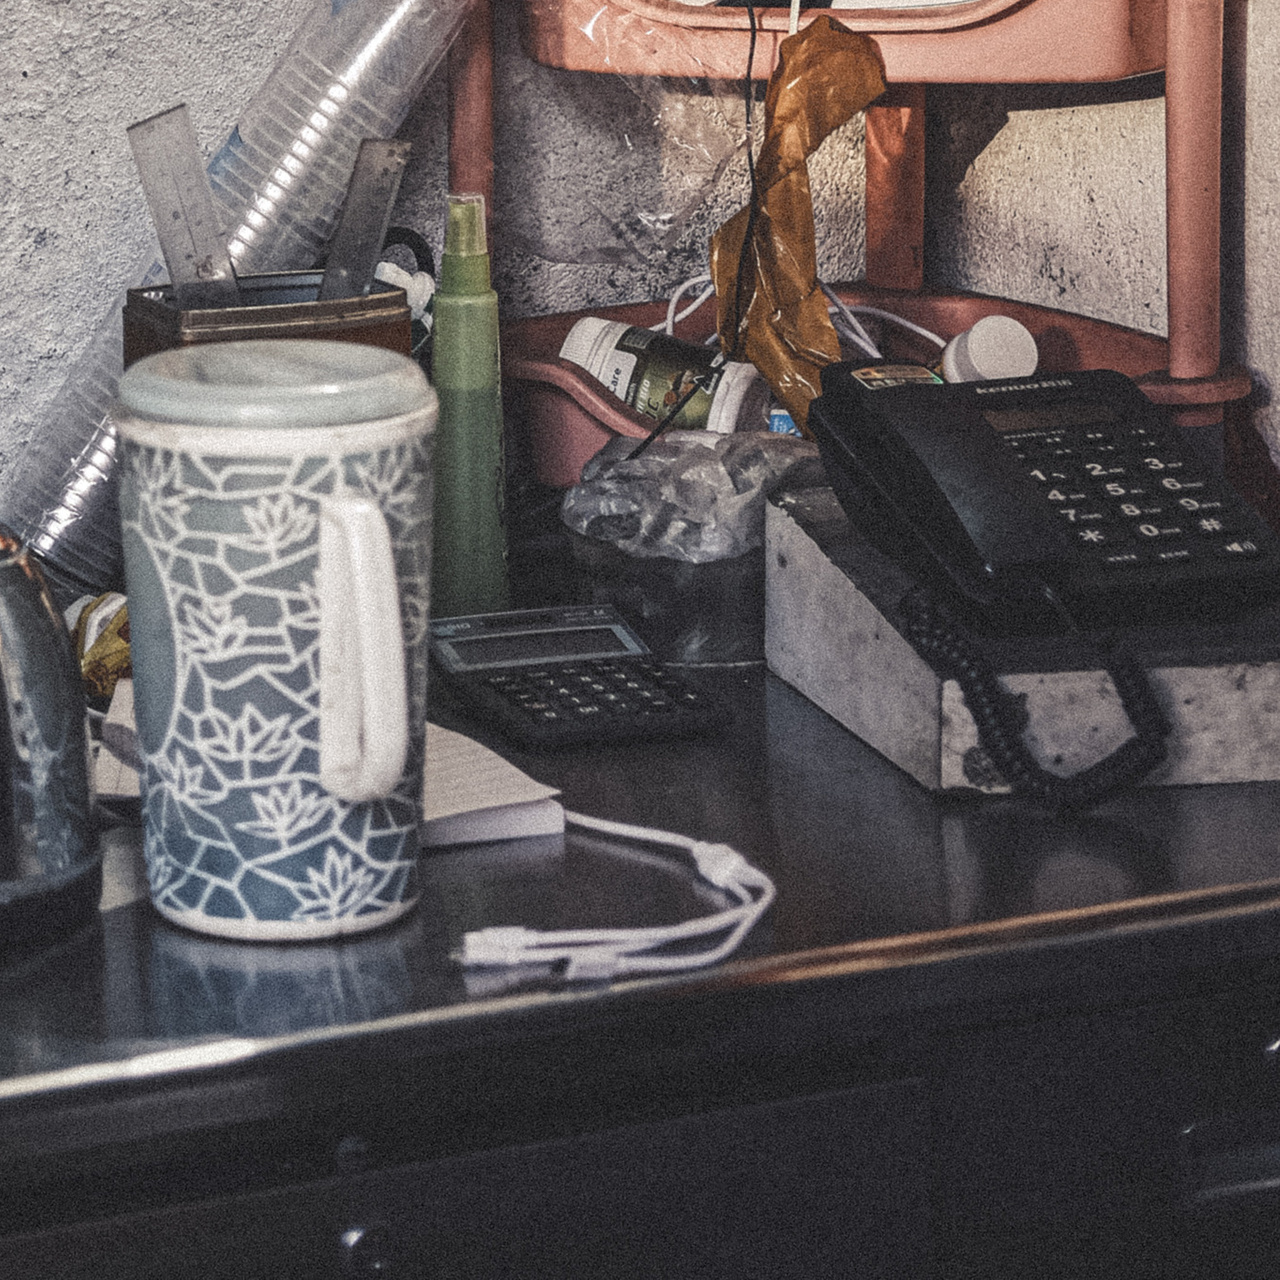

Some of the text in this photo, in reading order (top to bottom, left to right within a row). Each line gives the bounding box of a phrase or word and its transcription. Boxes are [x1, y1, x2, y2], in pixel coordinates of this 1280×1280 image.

[1030, 458, 1165, 481] 1 2 3
[1047, 478, 1182, 501] 4 5 6
[1060, 498, 1200, 522] 7 8 9
[1139, 524, 1159, 537] 0
